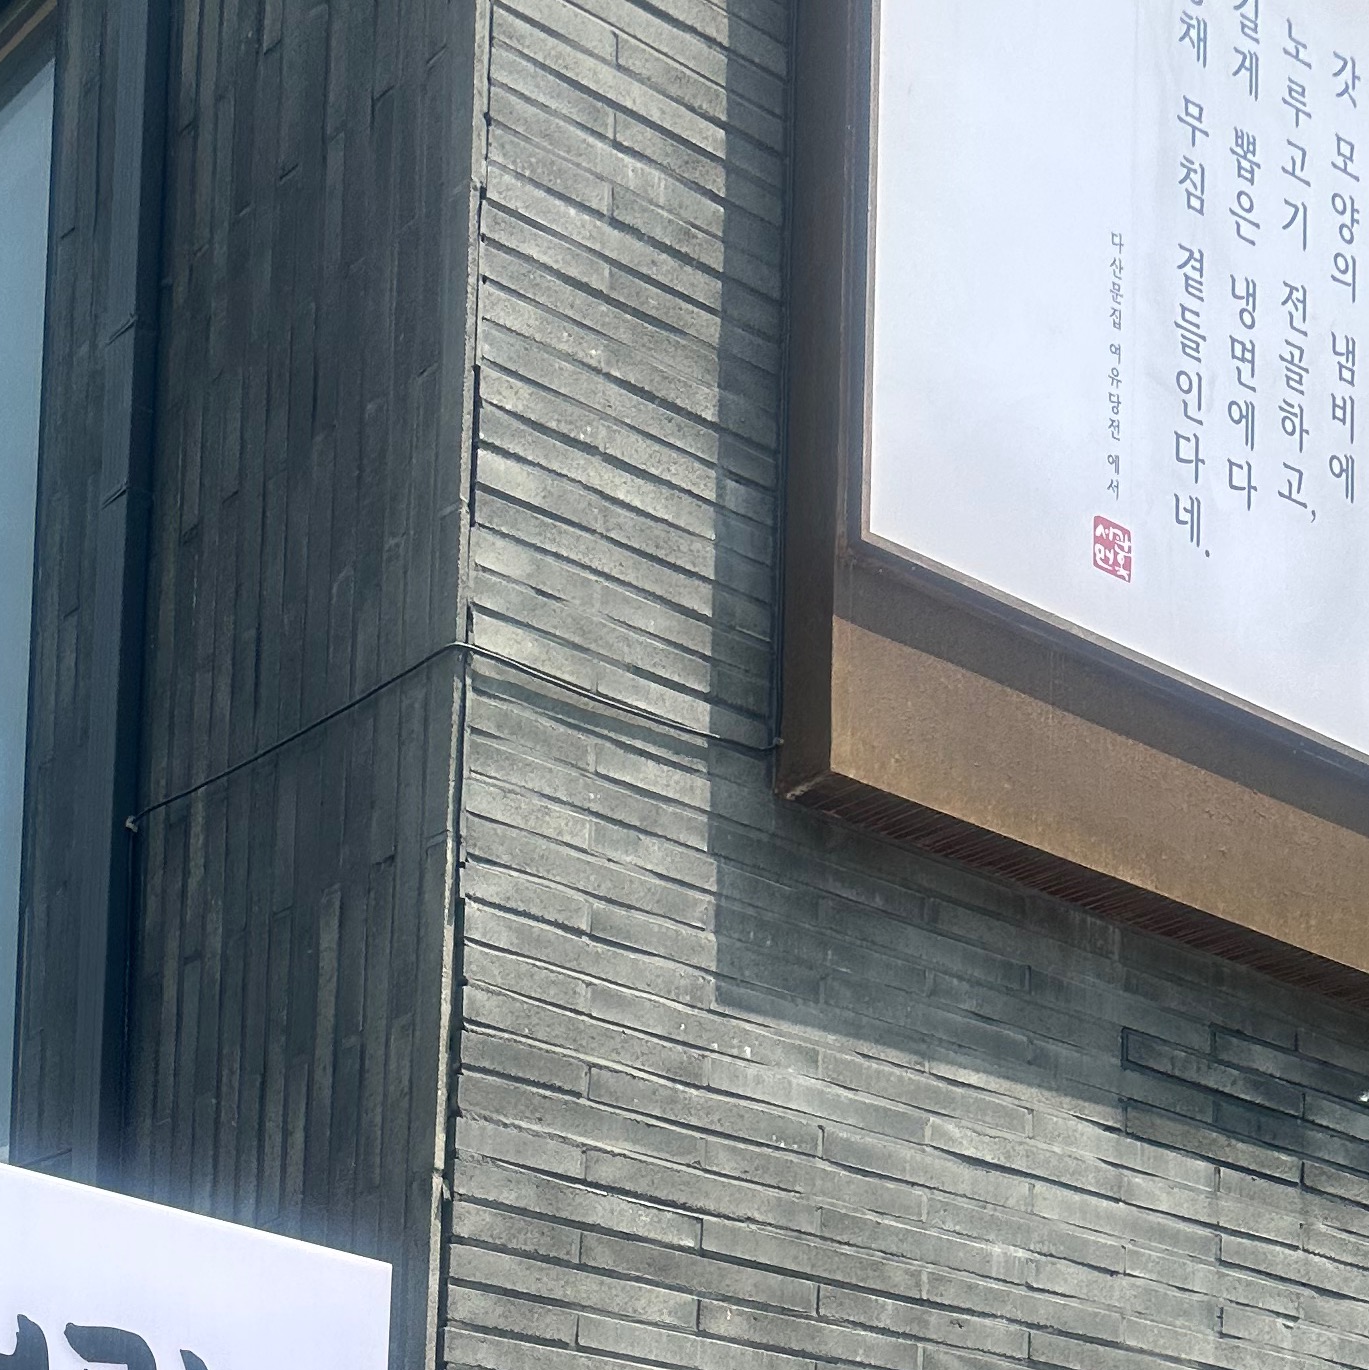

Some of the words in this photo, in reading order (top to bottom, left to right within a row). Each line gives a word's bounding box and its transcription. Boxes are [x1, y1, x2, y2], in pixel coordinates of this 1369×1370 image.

[1178, 0, 1208, 69] 채
[1232, 0, 1261, 102] 길게
[1332, 51, 1362, 109] 갓
[1176, 95, 1210, 216] 무침
[1229, 126, 1262, 246] 뽑은
[1281, 17, 1313, 252] 노루고기
[1330, 132, 1361, 304] 모양의
[1108, 231, 1125, 331] 다산문집
[1173, 243, 1211, 558] 곁들인다네.
[1227, 274, 1258, 511] 냉면에다
[1277, 280, 1317, 523] 전골하고,
[1328, 330, 1357, 504] 냄비에
[1106, 453, 1121, 501] 에서
